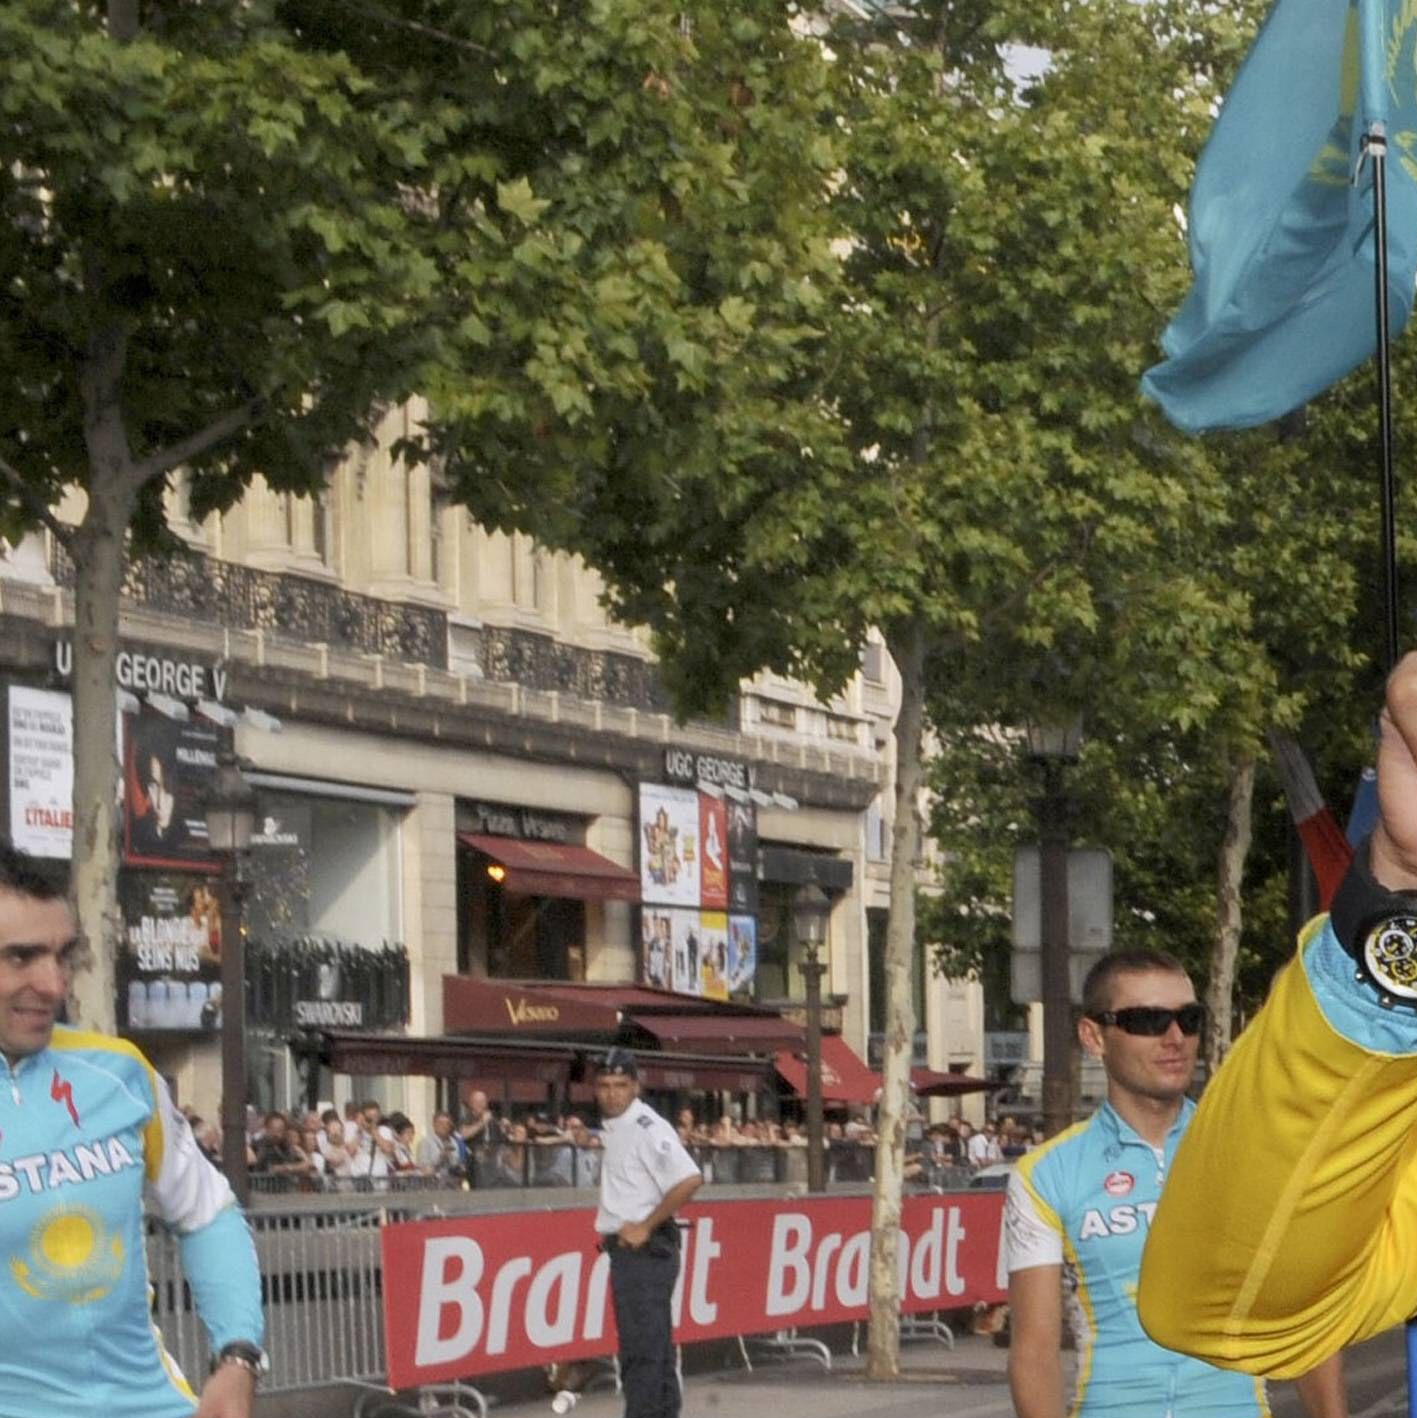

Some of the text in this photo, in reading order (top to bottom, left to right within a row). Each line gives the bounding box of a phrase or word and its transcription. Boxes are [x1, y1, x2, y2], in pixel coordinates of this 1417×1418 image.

[116, 652, 204, 697] GEORGE
[213, 669, 226, 701] V
[666, 751, 693, 778] UGC
[697, 757, 745, 786] GEORGE
[25, 807, 74, 829] L'ITALIE
[296, 1000, 362, 1025] SWAROVSKI
[1079, 1202, 1158, 1241] AST
